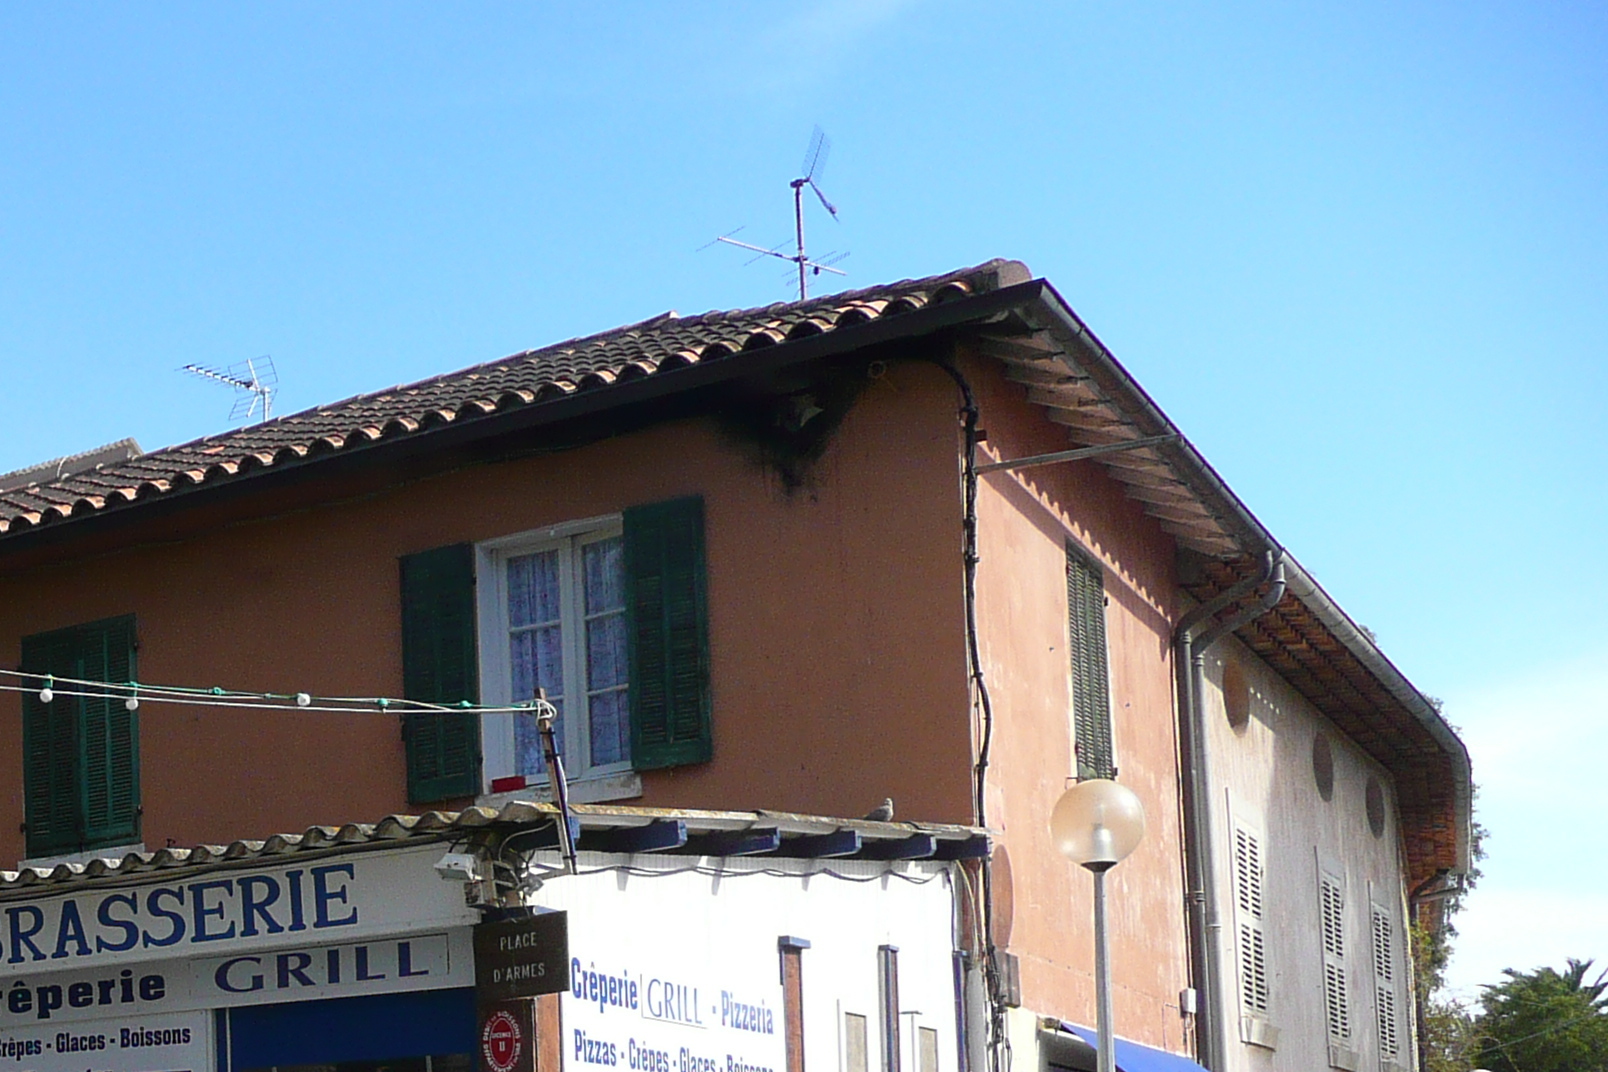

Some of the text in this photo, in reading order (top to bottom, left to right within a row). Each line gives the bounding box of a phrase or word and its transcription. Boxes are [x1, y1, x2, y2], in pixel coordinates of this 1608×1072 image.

[499, 931, 537, 951] PLACE
[214, 941, 429, 993] GRILL
[493, 962, 545, 983] D'ARMES
[570, 957, 638, 1014] Crêperie
[647, 978, 703, 1024] GRILL
[720, 990, 774, 1035] Pizzeria
[56, 1031, 106, 1054] Glaces
[120, 1026, 191, 1049] Boissons
[574, 1029, 617, 1067] Pizzas
